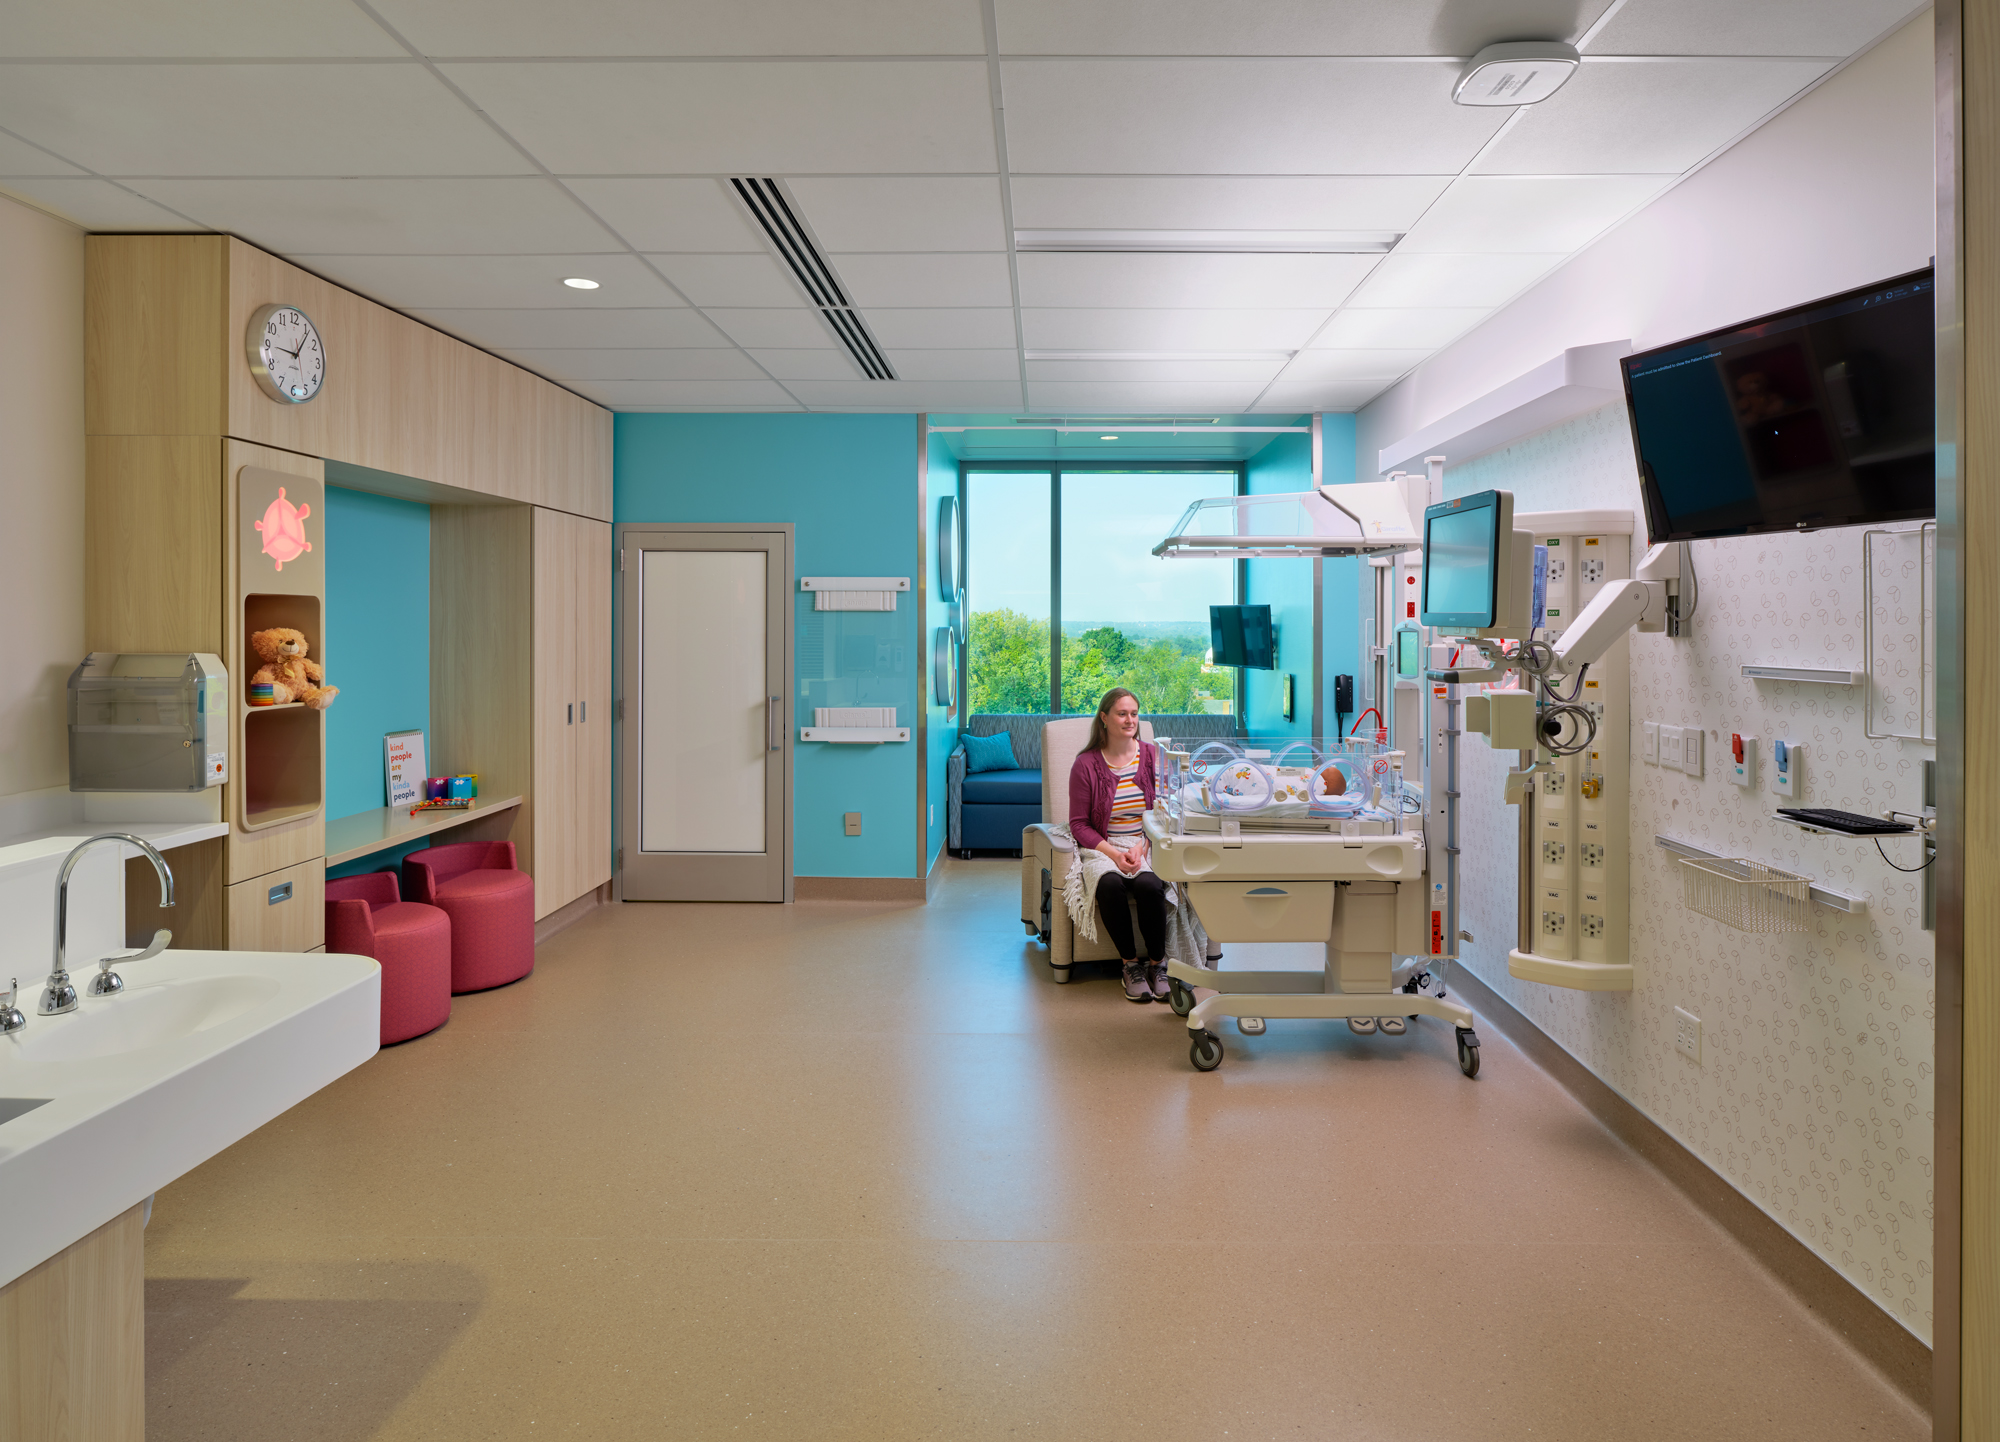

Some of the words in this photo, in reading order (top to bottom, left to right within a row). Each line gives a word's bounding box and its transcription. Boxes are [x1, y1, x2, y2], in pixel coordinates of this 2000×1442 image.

[278, 313, 286, 326] 11
[290, 312, 299, 325] 12
[267, 322, 277, 335] 10
[304, 324, 307, 334] 1
[265, 339, 270, 351] 9
[312, 339, 317, 351] 2
[269, 358, 274, 370] 8
[316, 358, 321, 369] 3
[279, 376, 285, 388] 7
[312, 374, 317, 385] 4
[291, 385, 296, 396] 6
[303, 384, 308, 396] 5
[390, 742, 404, 751] kind
[391, 751, 412, 764] people
[392, 774, 402, 782] my
[393, 781, 410, 790] kinda
[394, 789, 415, 802] people
